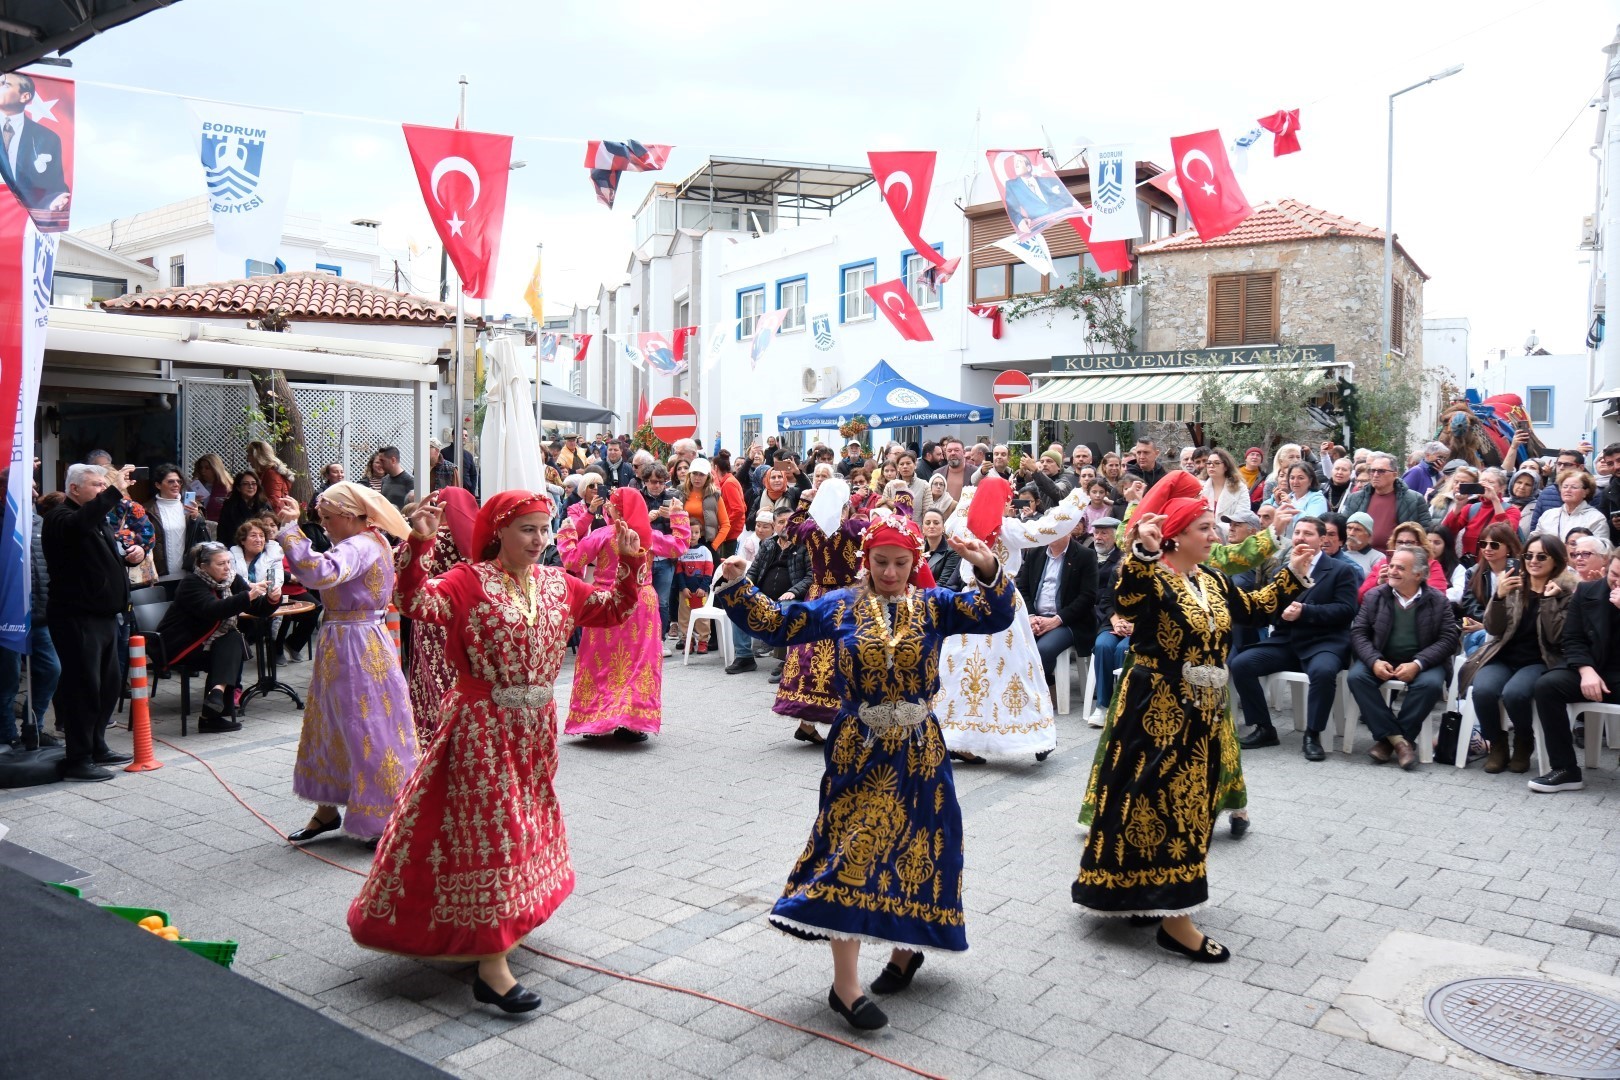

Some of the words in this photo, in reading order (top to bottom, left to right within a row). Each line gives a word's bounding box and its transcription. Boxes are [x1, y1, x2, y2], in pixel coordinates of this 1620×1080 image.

[202, 122, 266, 138] BODRUM
[1099, 151, 1123, 159] BODRUM
[211, 194, 264, 213] EDİYESİ
[1207, 352, 1219, 365] &
[1498, 1007, 1594, 1044] TELEFON
